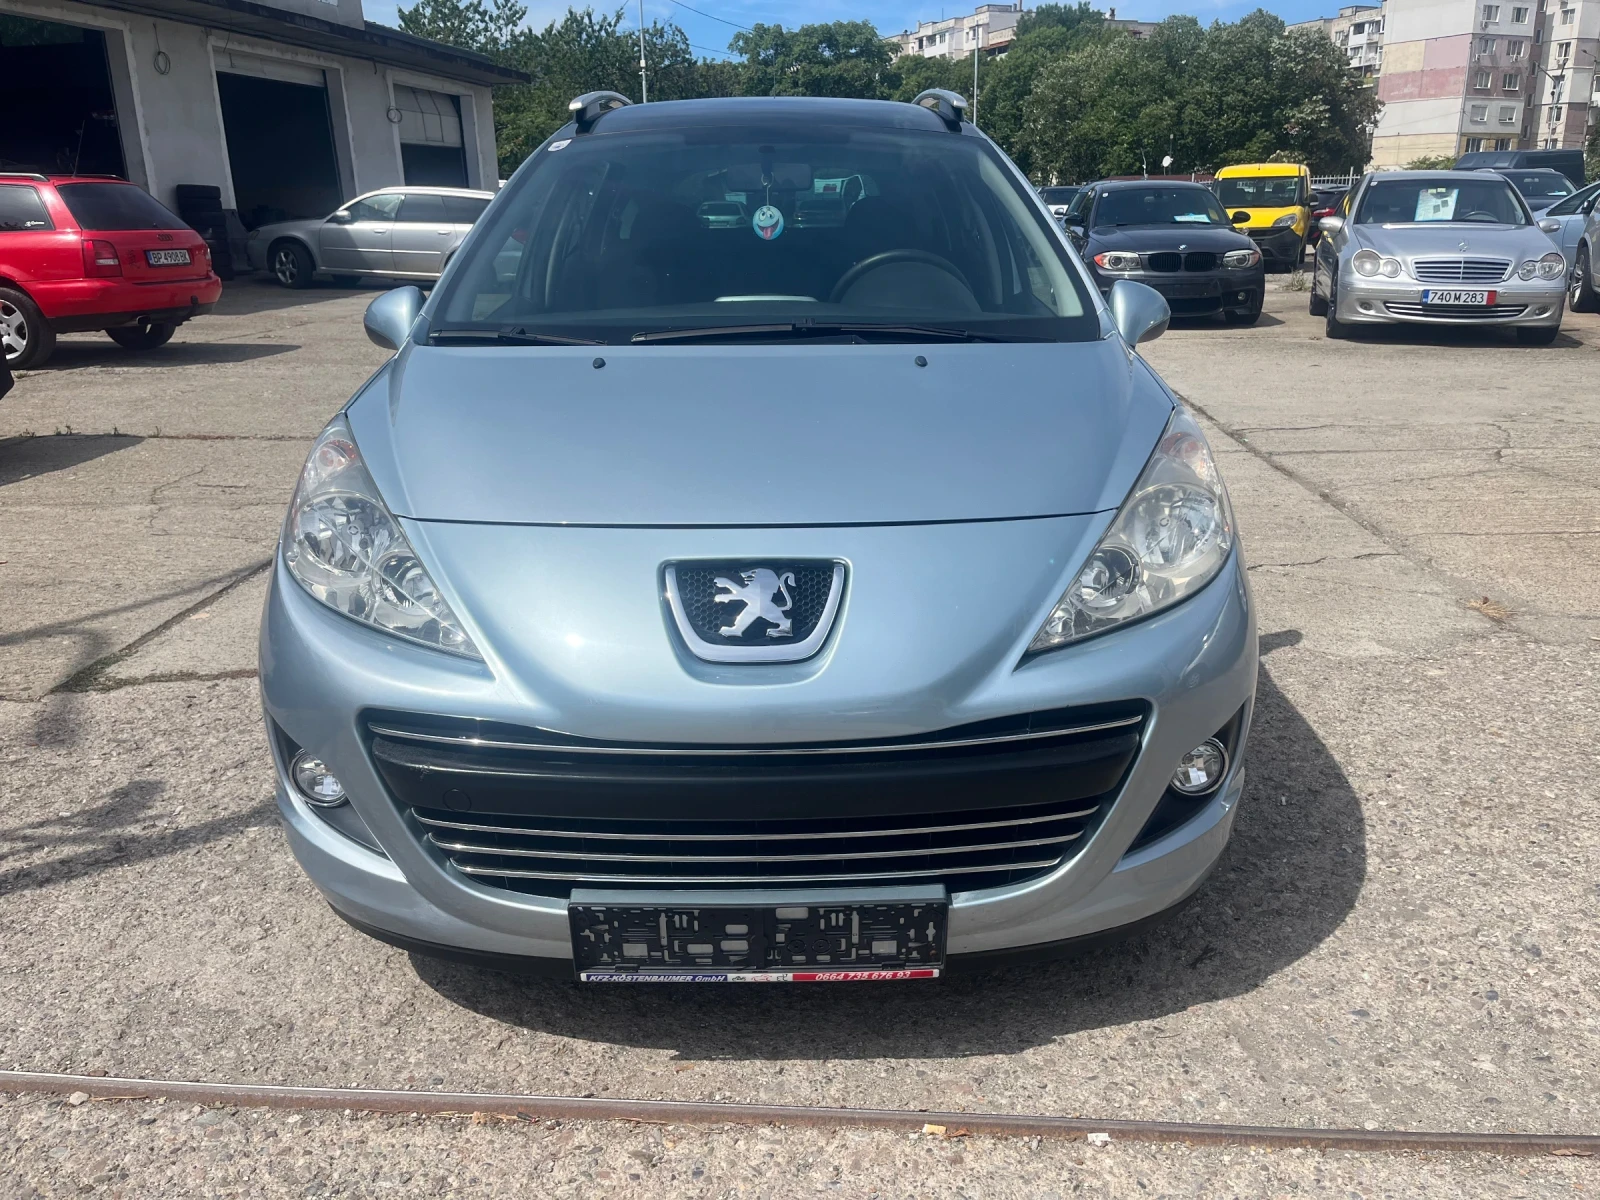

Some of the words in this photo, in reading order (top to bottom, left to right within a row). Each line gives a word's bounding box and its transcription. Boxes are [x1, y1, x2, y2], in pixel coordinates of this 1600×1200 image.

[1430, 291, 1452, 303] 740
[1453, 292, 1462, 303] M
[1462, 292, 1485, 304] 283
[815, 973, 843, 981] 0664
[871, 972, 892, 980] 676
[895, 971, 911, 979] 93
